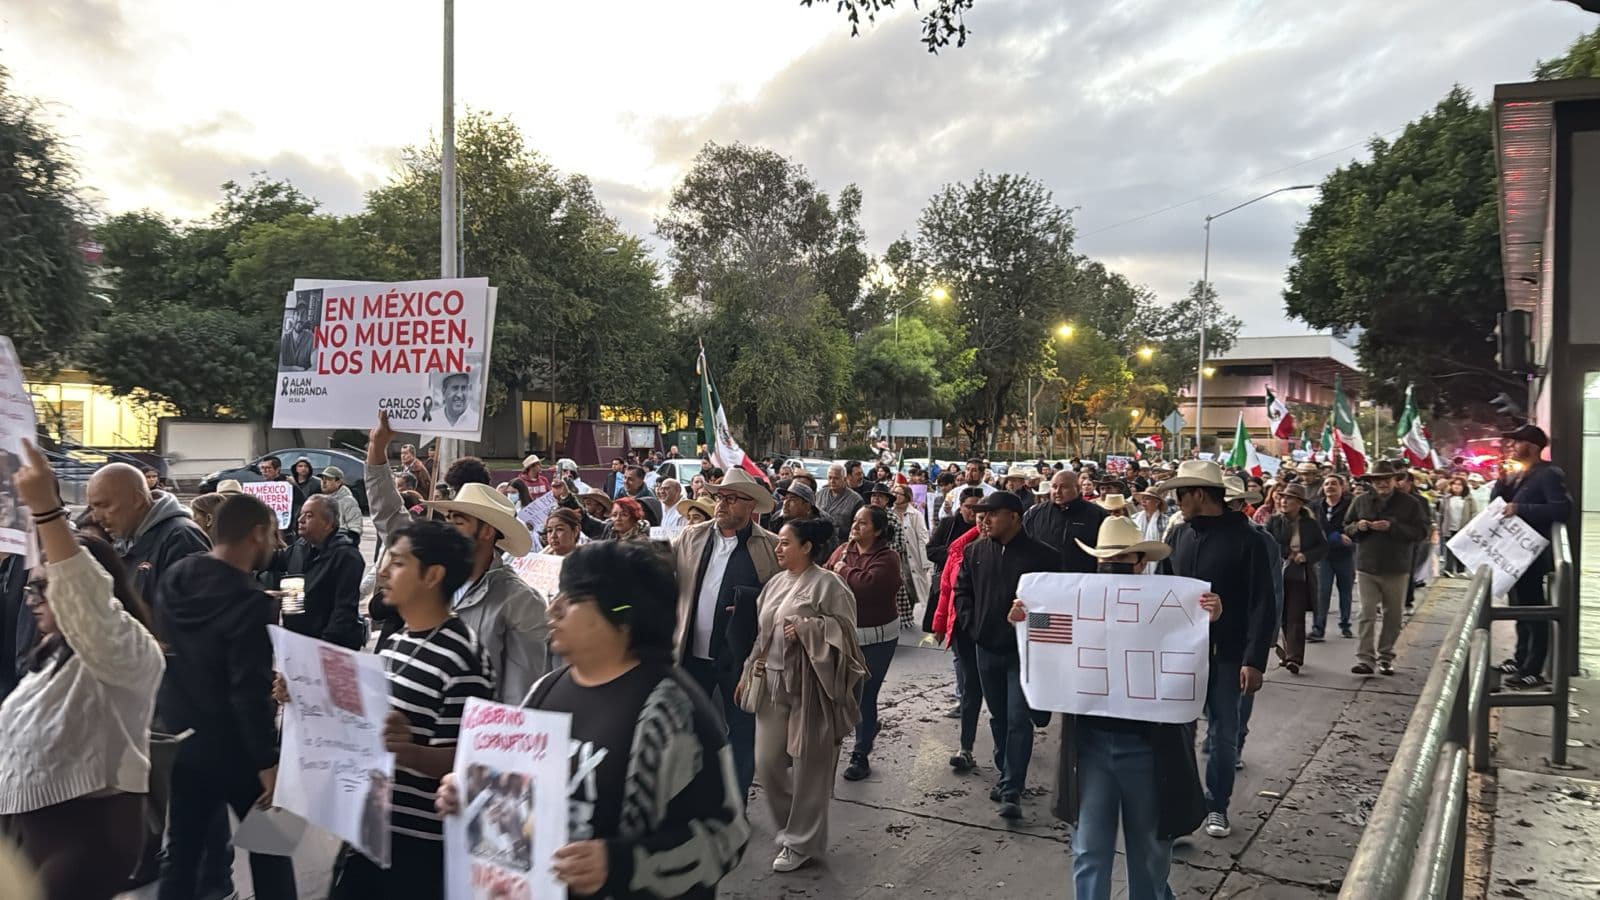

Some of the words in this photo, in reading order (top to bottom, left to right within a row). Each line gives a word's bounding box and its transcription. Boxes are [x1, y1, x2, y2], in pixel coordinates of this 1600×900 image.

[324, 297, 356, 322] EN
[362, 289, 464, 320] MÉXICO
[313, 323, 348, 349] NO
[355, 319, 474, 349] MUEREN,
[318, 350, 363, 375] LOS
[370, 348, 472, 374] MATAN.
[289, 377, 312, 387] ALAN
[289, 387, 328, 397] MIRANDA
[379, 398, 421, 409] CARLOS
[244, 486, 254, 494] EN
[1077, 586, 1194, 627] USA
[1077, 646, 1196, 701] SOS
